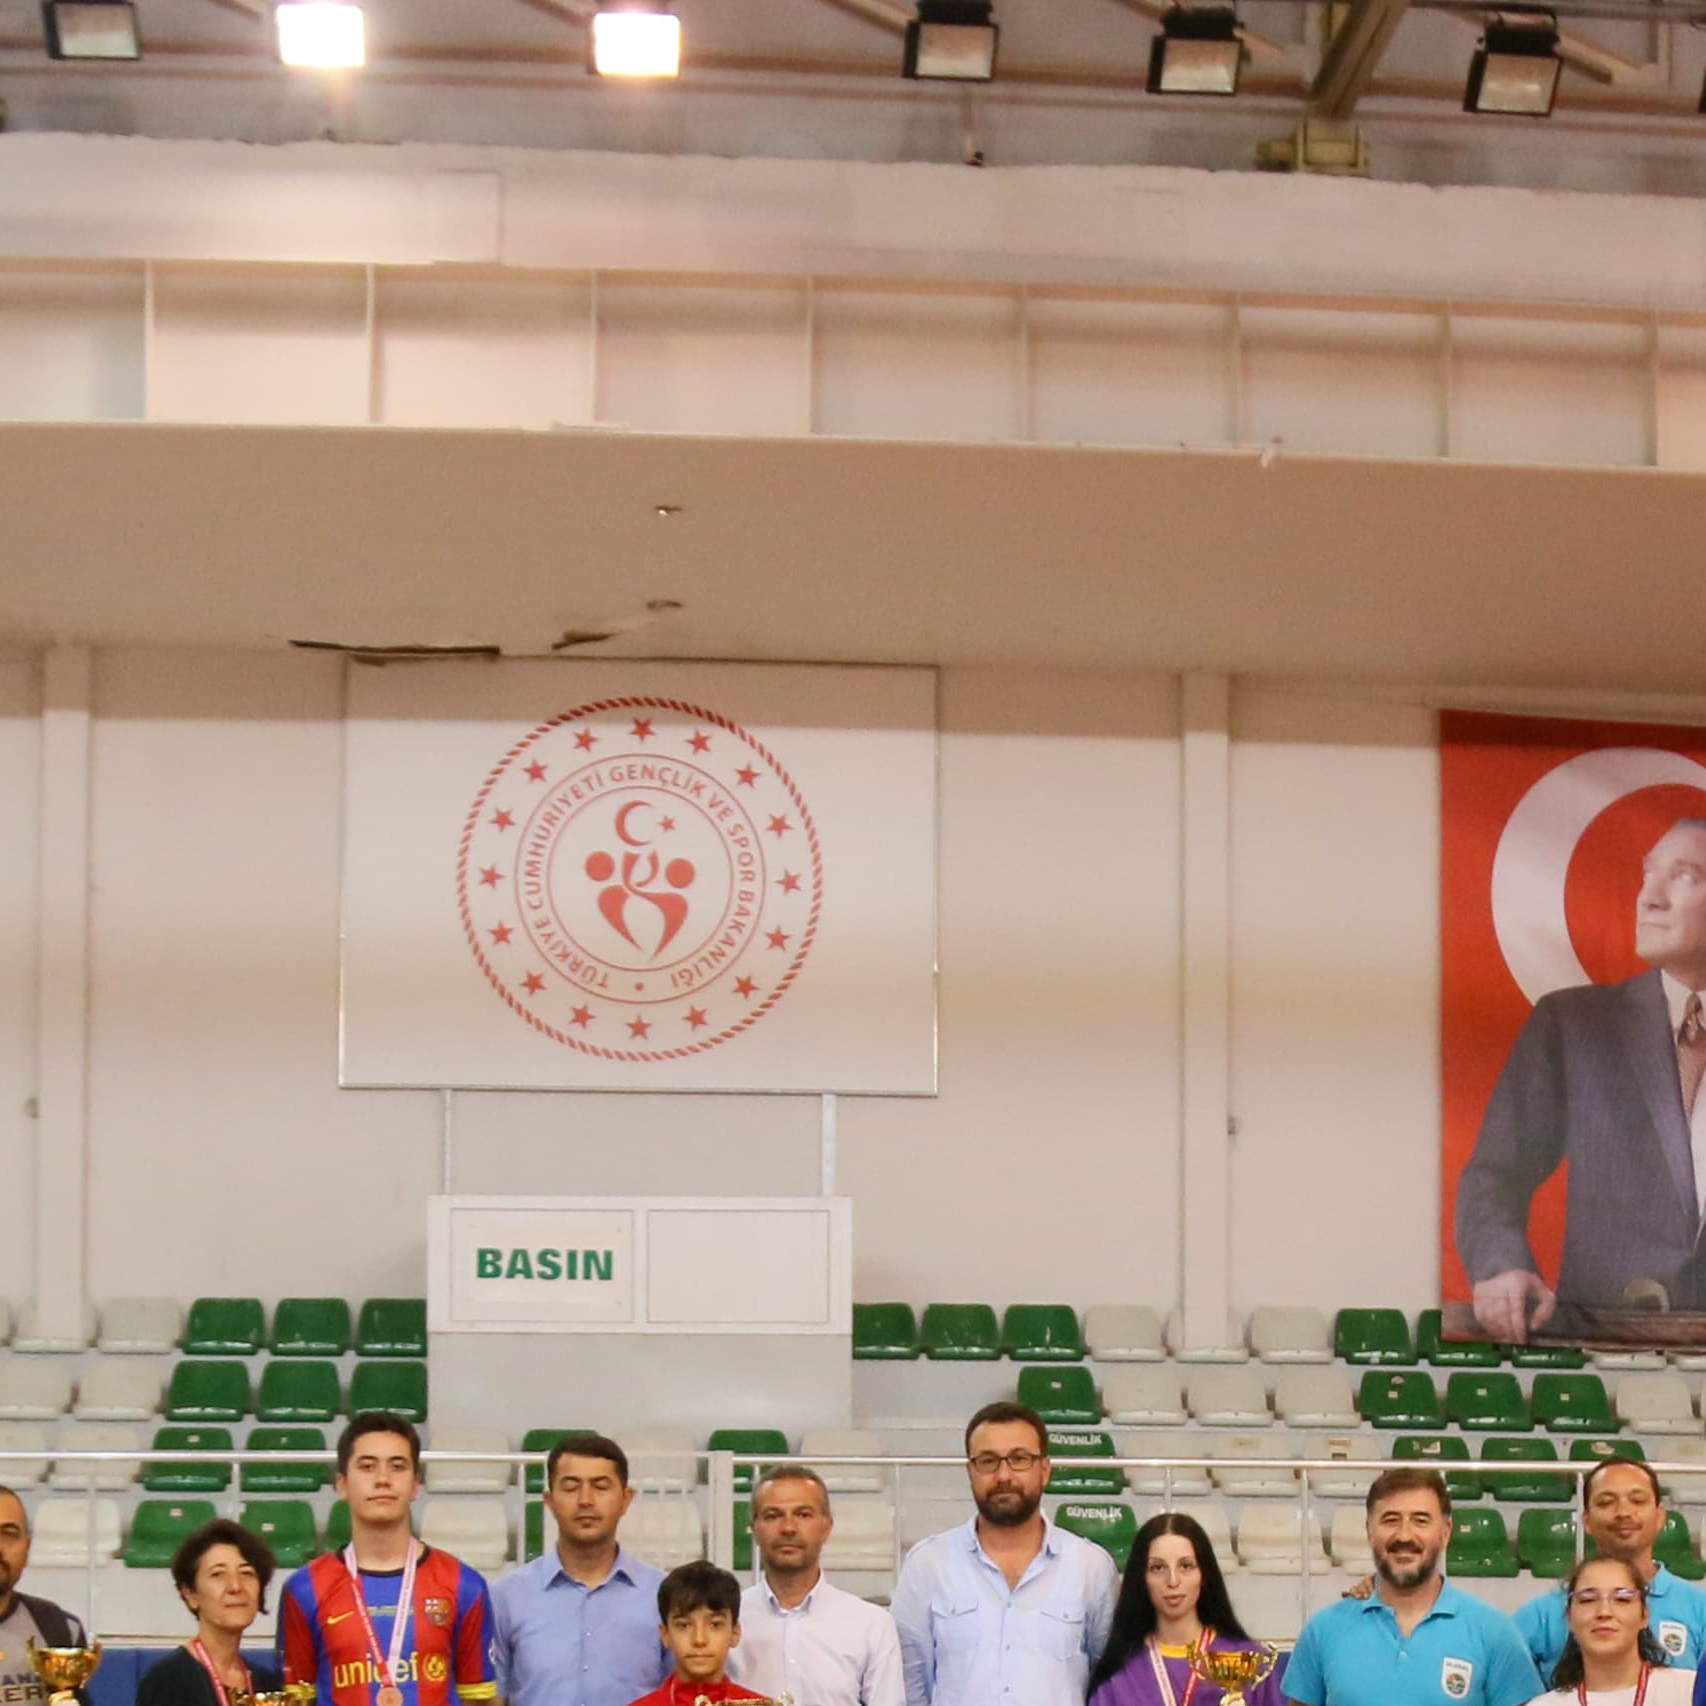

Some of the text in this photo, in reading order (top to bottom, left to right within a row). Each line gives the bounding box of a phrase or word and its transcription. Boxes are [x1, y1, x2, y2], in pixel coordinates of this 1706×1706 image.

[525, 763, 756, 988] TÜRKİYE CUMHURİYETİ GENÇLİK VE SPOR BAKANLIĞI
[476, 1247, 614, 1281] BASIN
[1048, 1432, 1102, 1445] GÜVENLİK
[1066, 1506, 1122, 1519] GÜVENLİK
